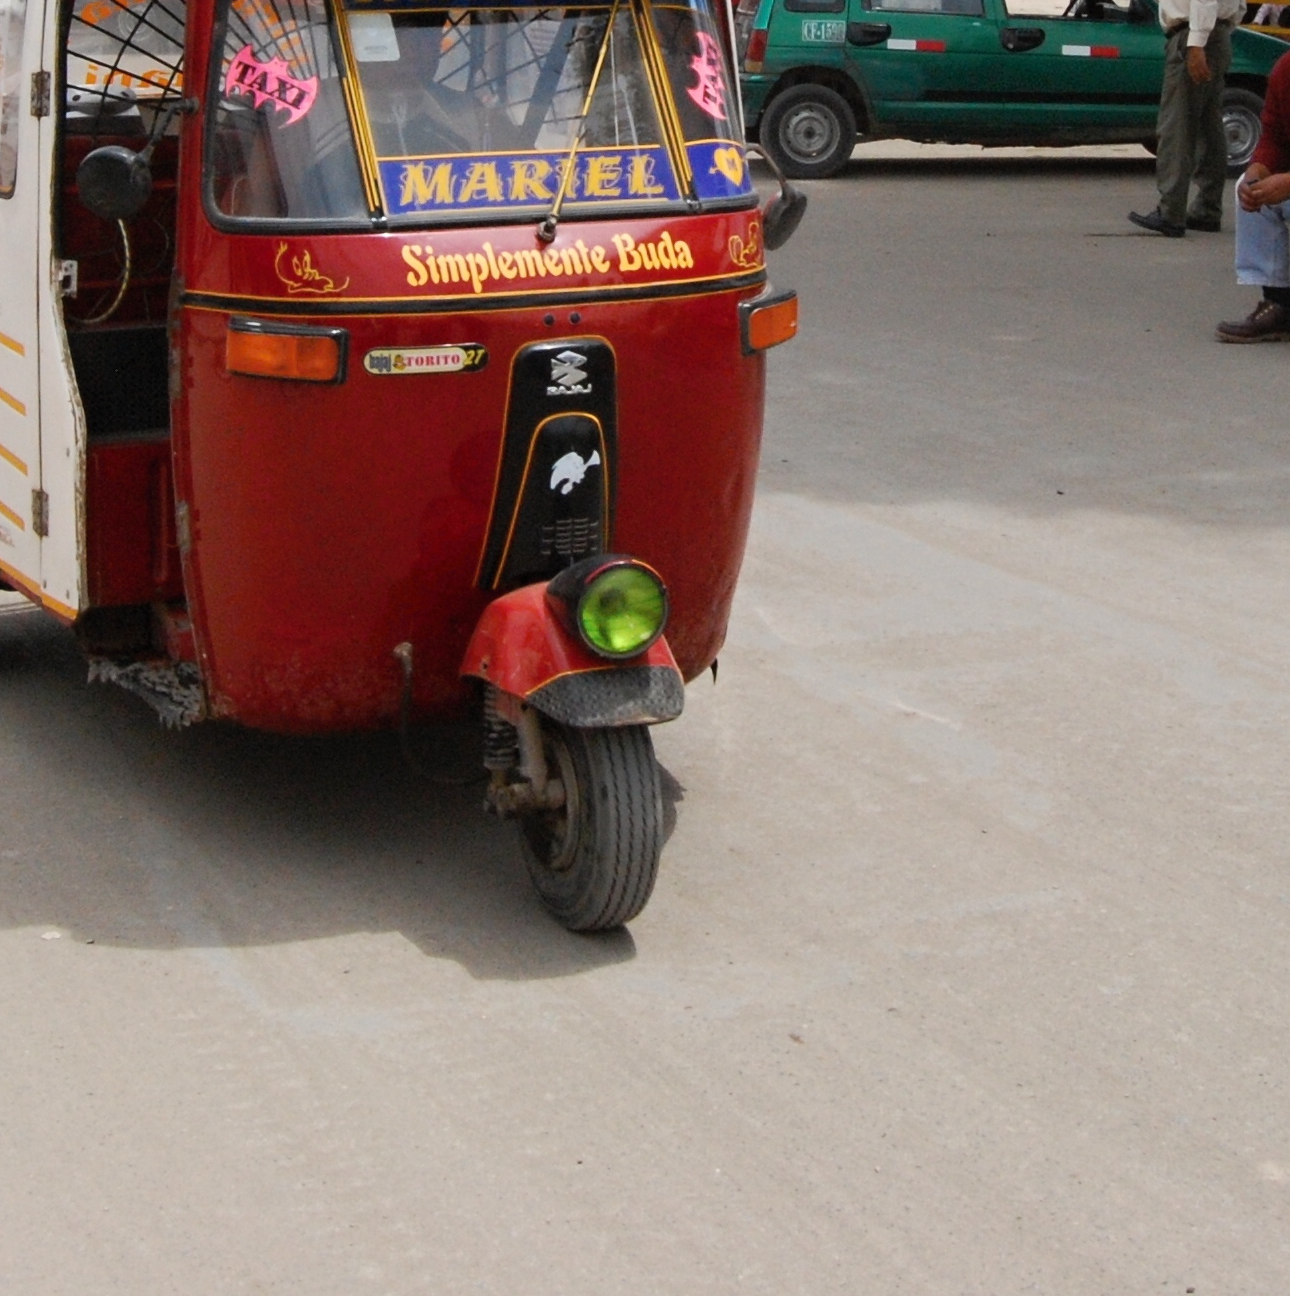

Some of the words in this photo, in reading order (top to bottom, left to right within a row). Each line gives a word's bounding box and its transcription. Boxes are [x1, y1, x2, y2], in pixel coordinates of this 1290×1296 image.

[235, 60, 310, 110] TAXI
[400, 154, 666, 206] MARIEL
[402, 240, 610, 294] Simplemente
[611, 230, 694, 273] Buda
[405, 354, 461, 367] TORITO
